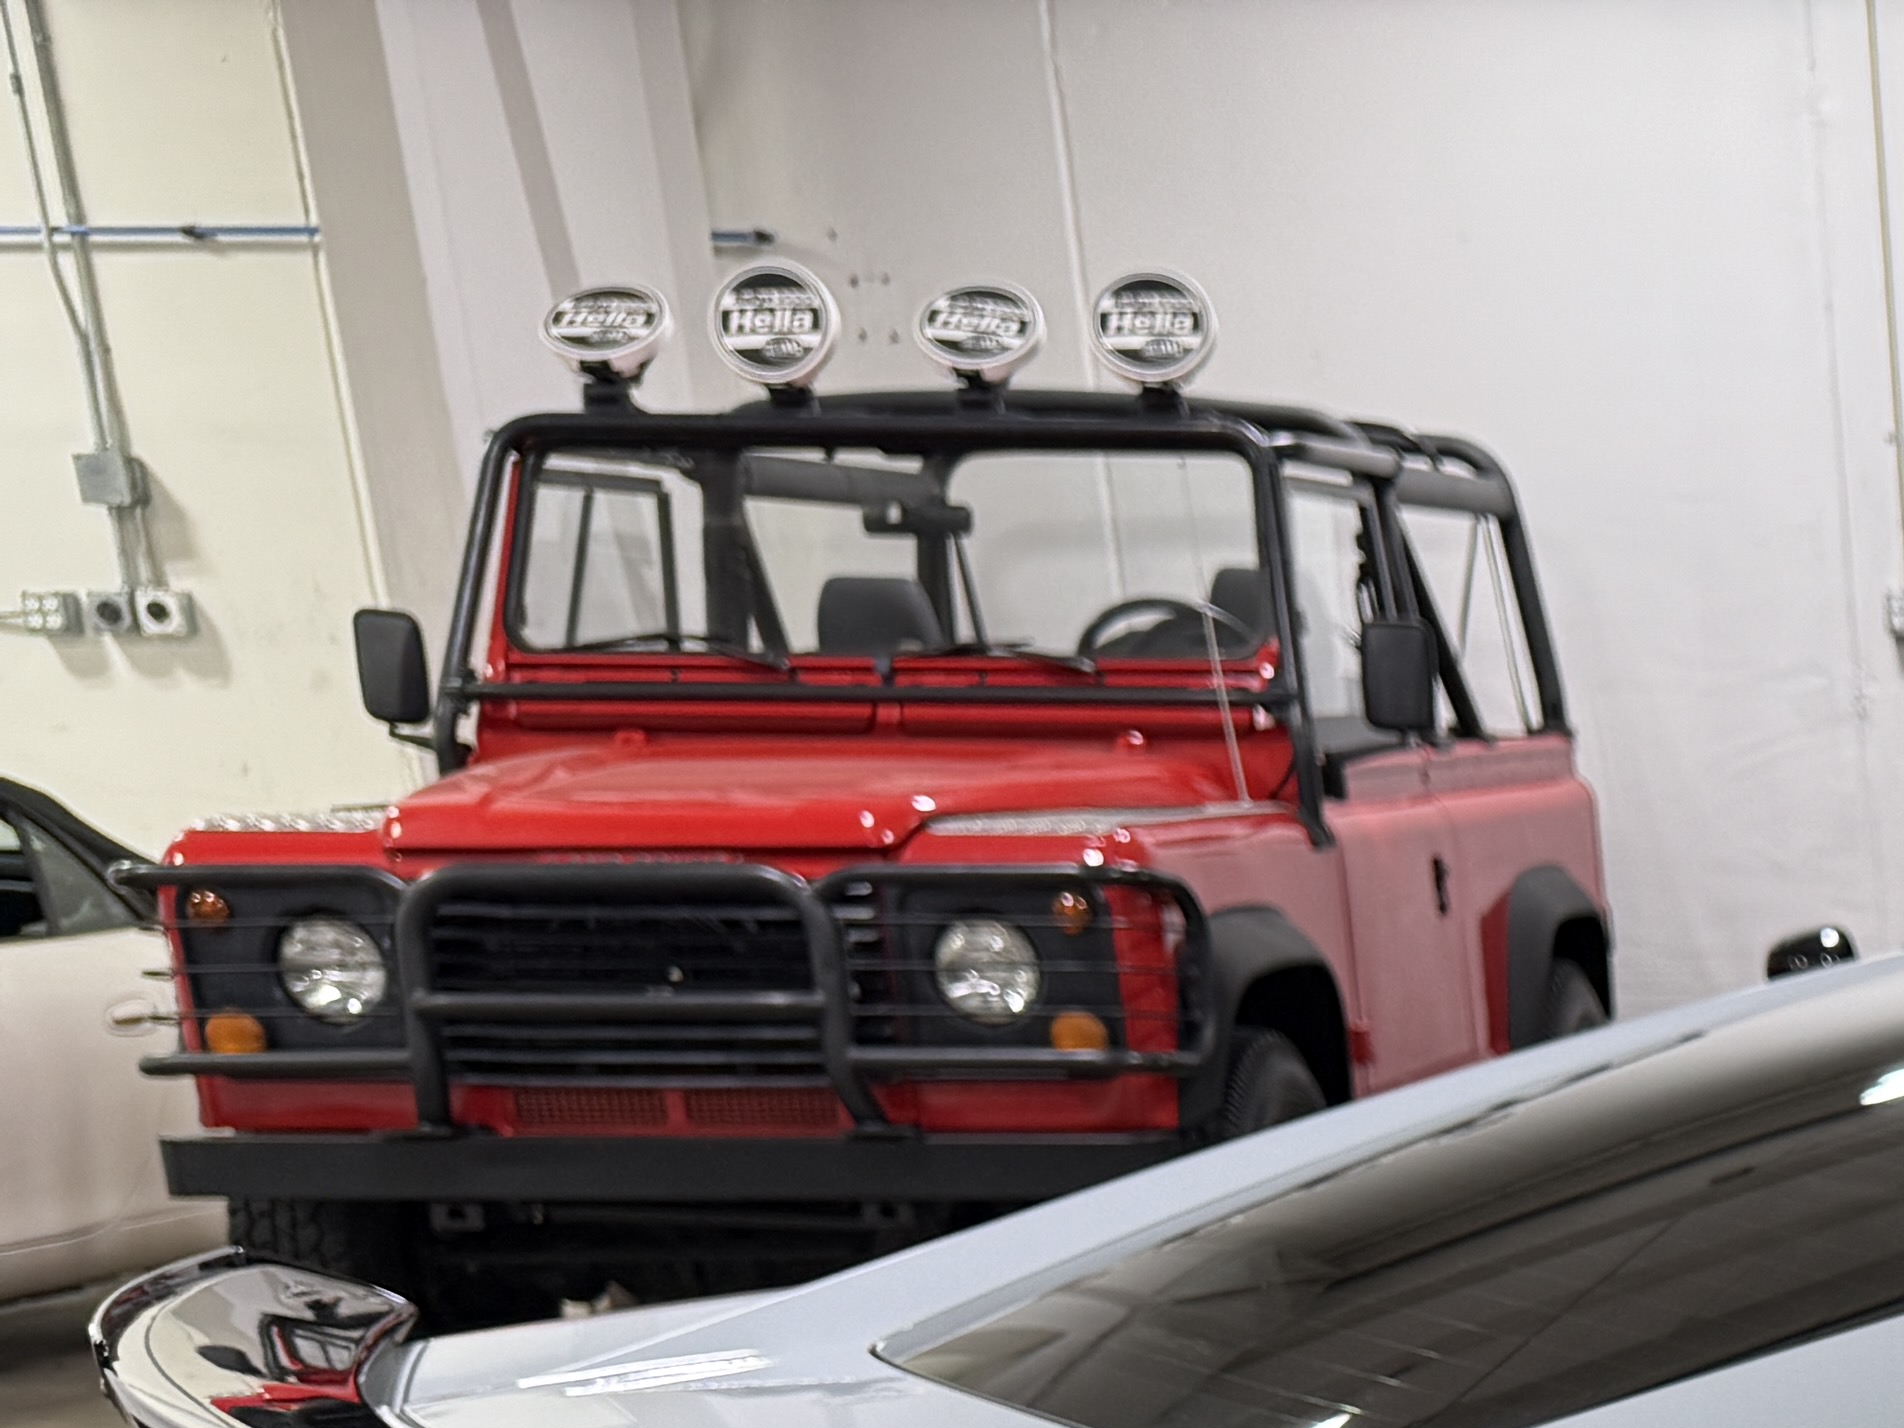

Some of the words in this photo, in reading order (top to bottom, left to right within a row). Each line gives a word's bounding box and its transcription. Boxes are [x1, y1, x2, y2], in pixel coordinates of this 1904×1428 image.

[560, 311, 648, 328] Hella
[727, 308, 814, 334] Hella
[934, 311, 1020, 337] Hella
[1106, 311, 1194, 336] Hella
